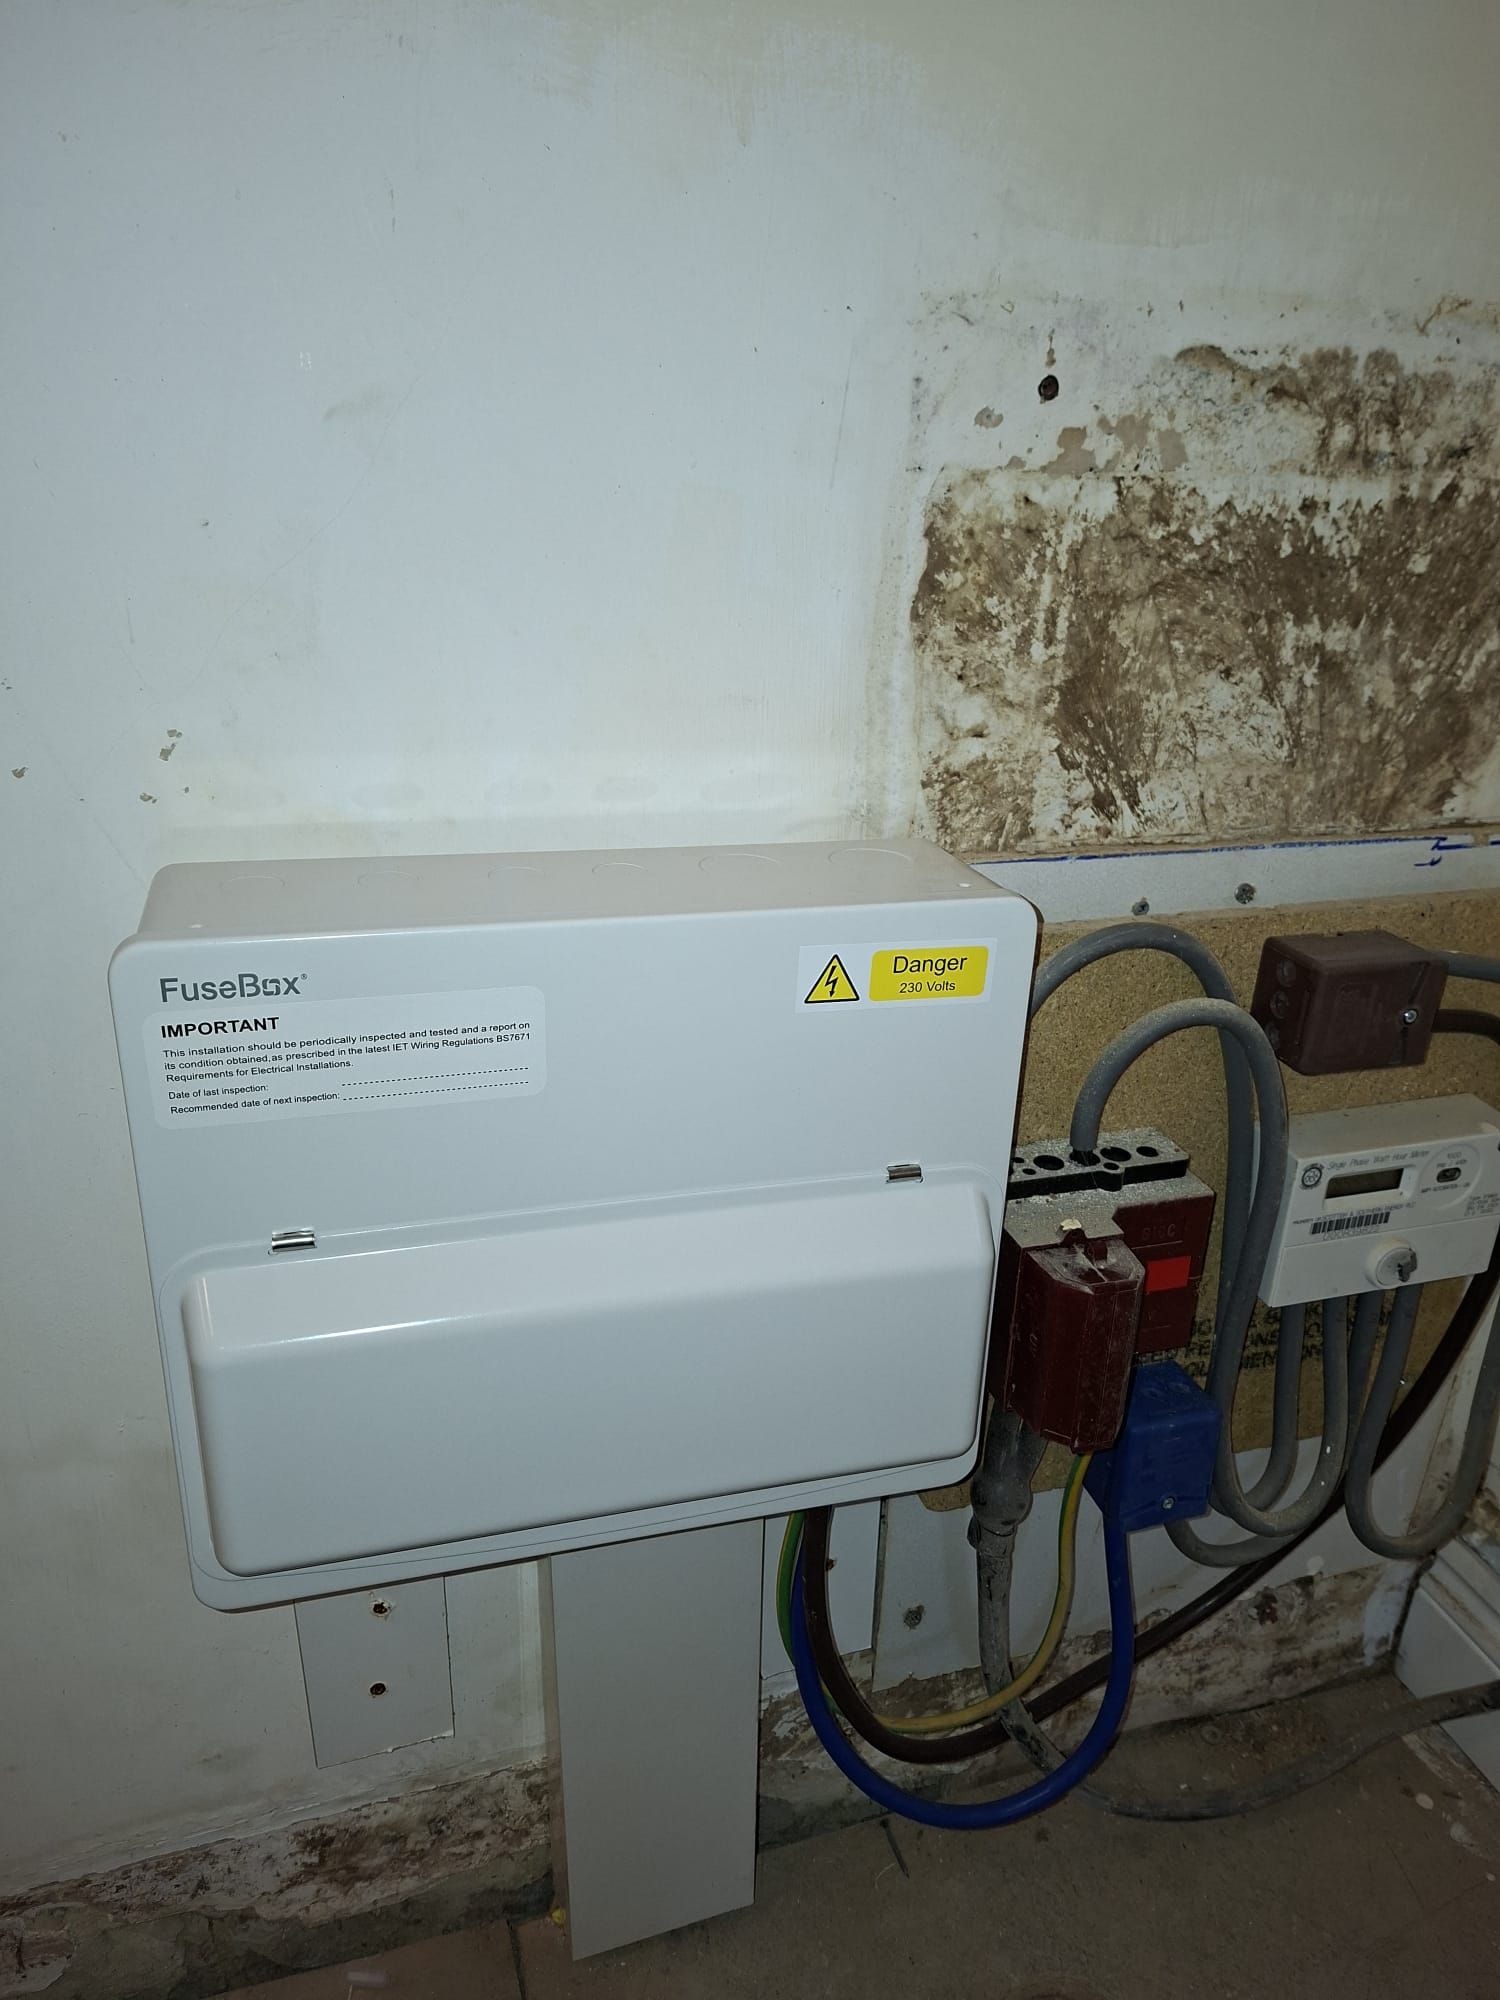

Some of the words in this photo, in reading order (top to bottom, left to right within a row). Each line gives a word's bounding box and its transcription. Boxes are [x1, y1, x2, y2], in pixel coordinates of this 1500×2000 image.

[893, 955, 968, 976] Danger
[899, 981, 923, 994] 230
[926, 980, 956, 992] Volts
[160, 1016, 280, 1039] IMPORTANT
[162, 1048, 186, 1058] This
[188, 1044, 245, 1056] installation
[247, 1041, 282, 1052] should
[284, 1040, 297, 1049] be
[299, 1035, 357, 1049] periodically
[359, 1031, 406, 1043] inspected
[408, 1029, 427, 1039] and
[429, 1027, 459, 1037] tested
[461, 1025, 479, 1034] and
[489, 1022, 517, 1033] report
[518, 1022, 531, 1030] on
[163, 1062, 176, 1071] its
[178, 1058, 224, 1069] condition
[226, 1054, 271, 1065] obtained,
[271, 1054, 283, 1062] as
[285, 1048, 335, 1062] prescribed
[337, 1047, 346, 1056] in
[348, 1046, 363, 1055] the
[365, 1044, 391, 1054] latest
[392, 1042, 408, 1052] IET
[410, 1040, 440, 1051] Wiring
[442, 1036, 495, 1048] Regulations
[496, 1032, 530, 1043] BS7671
[166, 1069, 234, 1083] Requirements
[235, 1068, 249, 1077] for
[250, 1064, 294, 1076] Electrical
[296, 1060, 354, 1072] Installations.
[168, 1091, 190, 1100] Date
[192, 1089, 201, 1098] of
[203, 1087, 220, 1097] last
[221, 1084, 269, 1096] inspection:
[170, 1101, 239, 1114] Recommended
[240, 1099, 261, 1108] date
[262, 1097, 272, 1106] of
[273, 1096, 293, 1105] next
[294, 1092, 340, 1104] inspection:
